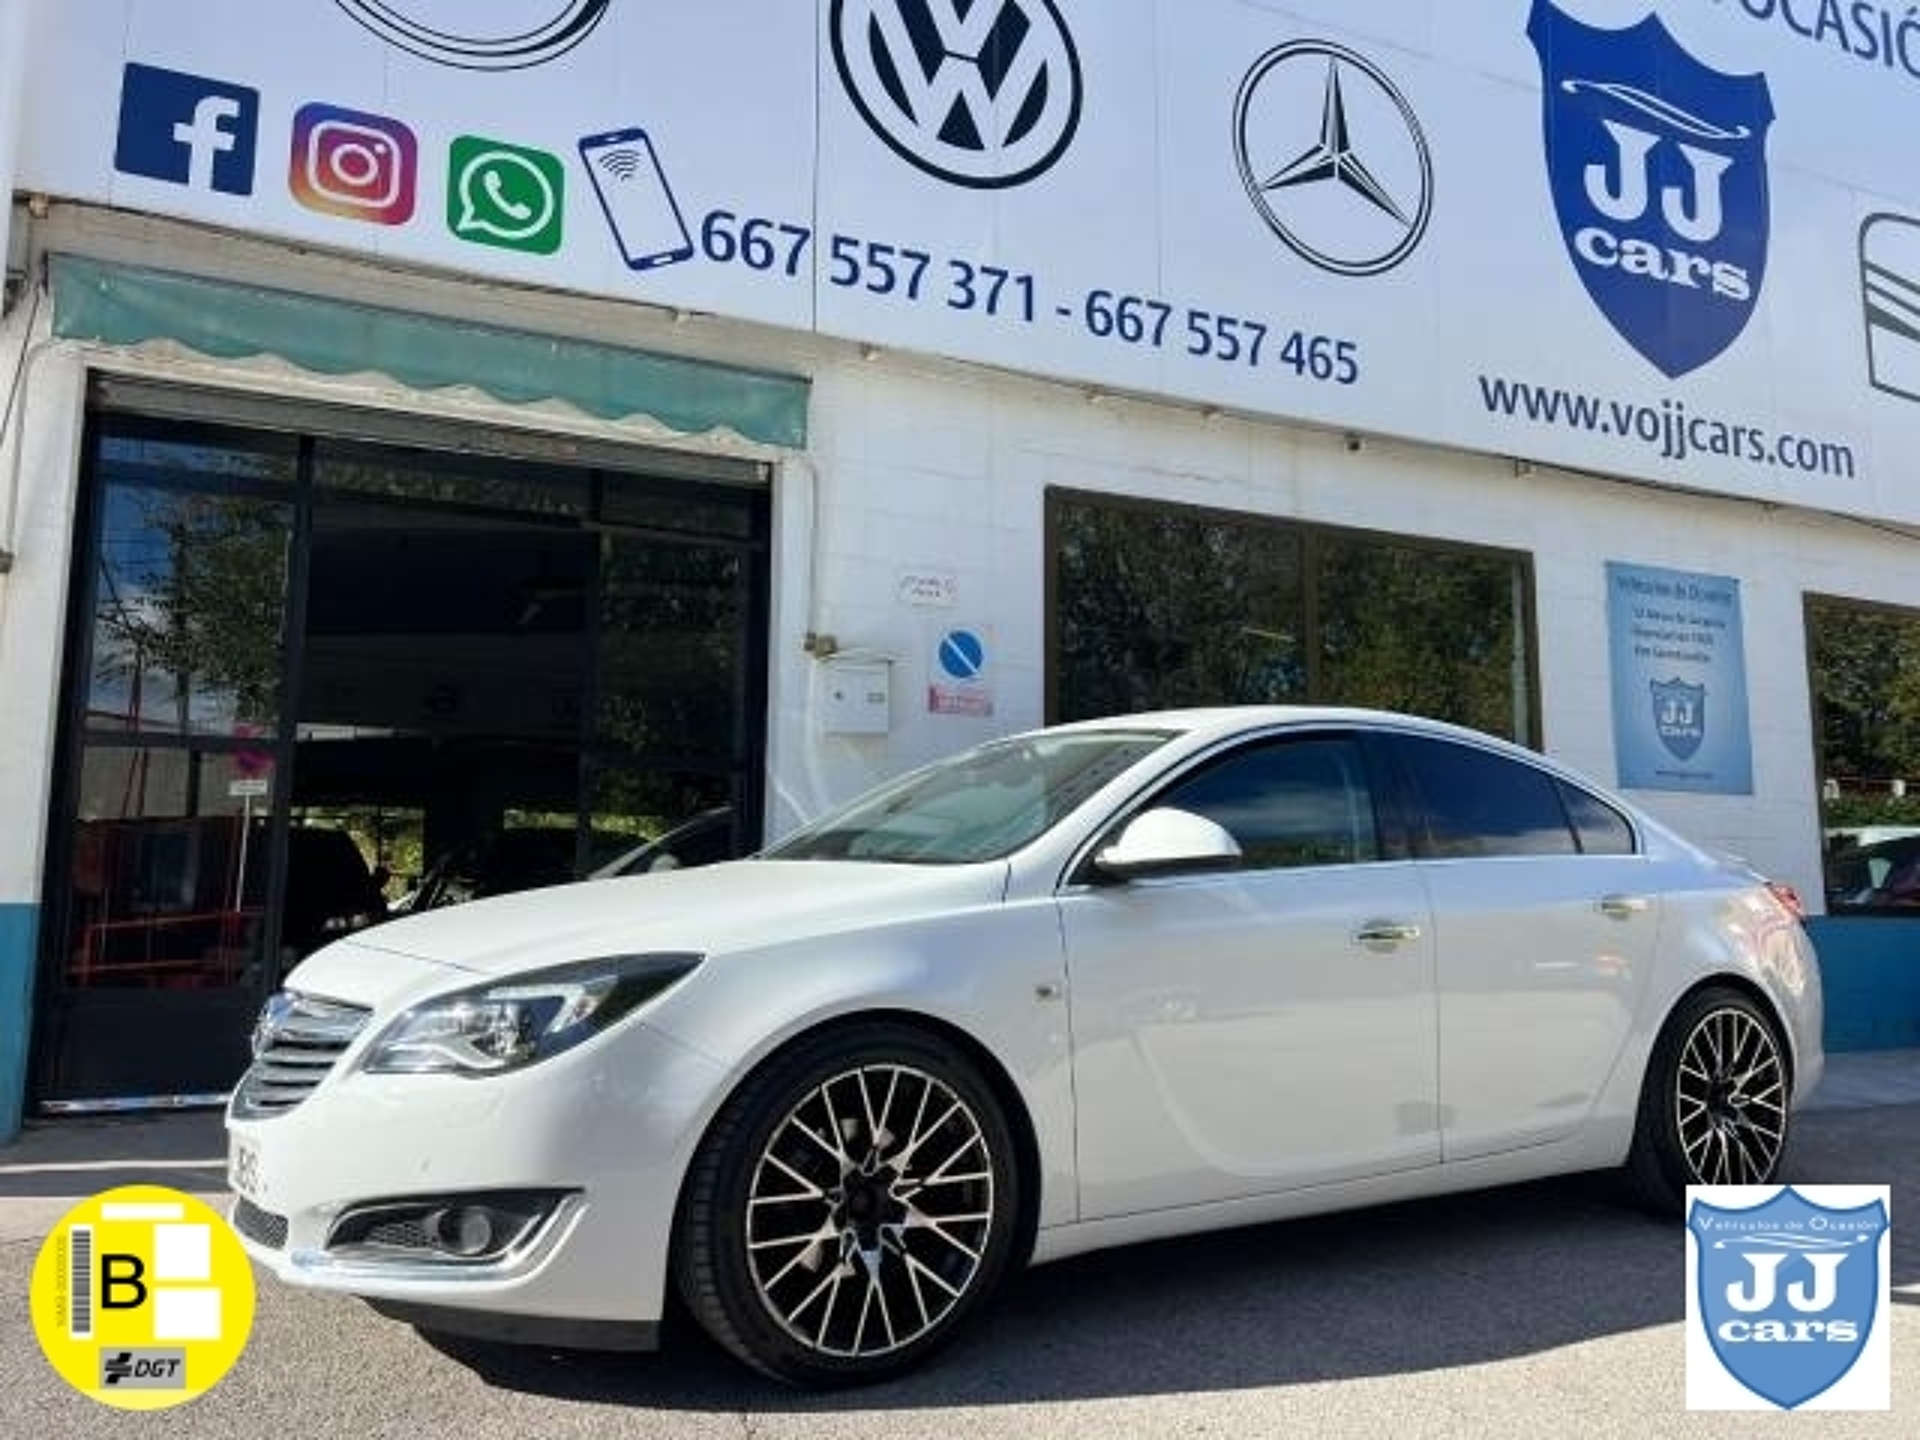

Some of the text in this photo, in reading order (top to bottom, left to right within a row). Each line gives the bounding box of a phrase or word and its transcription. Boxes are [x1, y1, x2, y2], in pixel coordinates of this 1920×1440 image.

[1584, 119, 1734, 243] JJ
[700, 209, 811, 277] 667
[829, 233, 931, 300] 557
[946, 259, 1034, 322] 371
[1085, 289, 1172, 347] 667
[1186, 310, 1268, 367] 557
[1280, 330, 1359, 385] 465
[1574, 226, 1751, 302] cars
[1478, 375, 1855, 479] www.vojjcars.com
